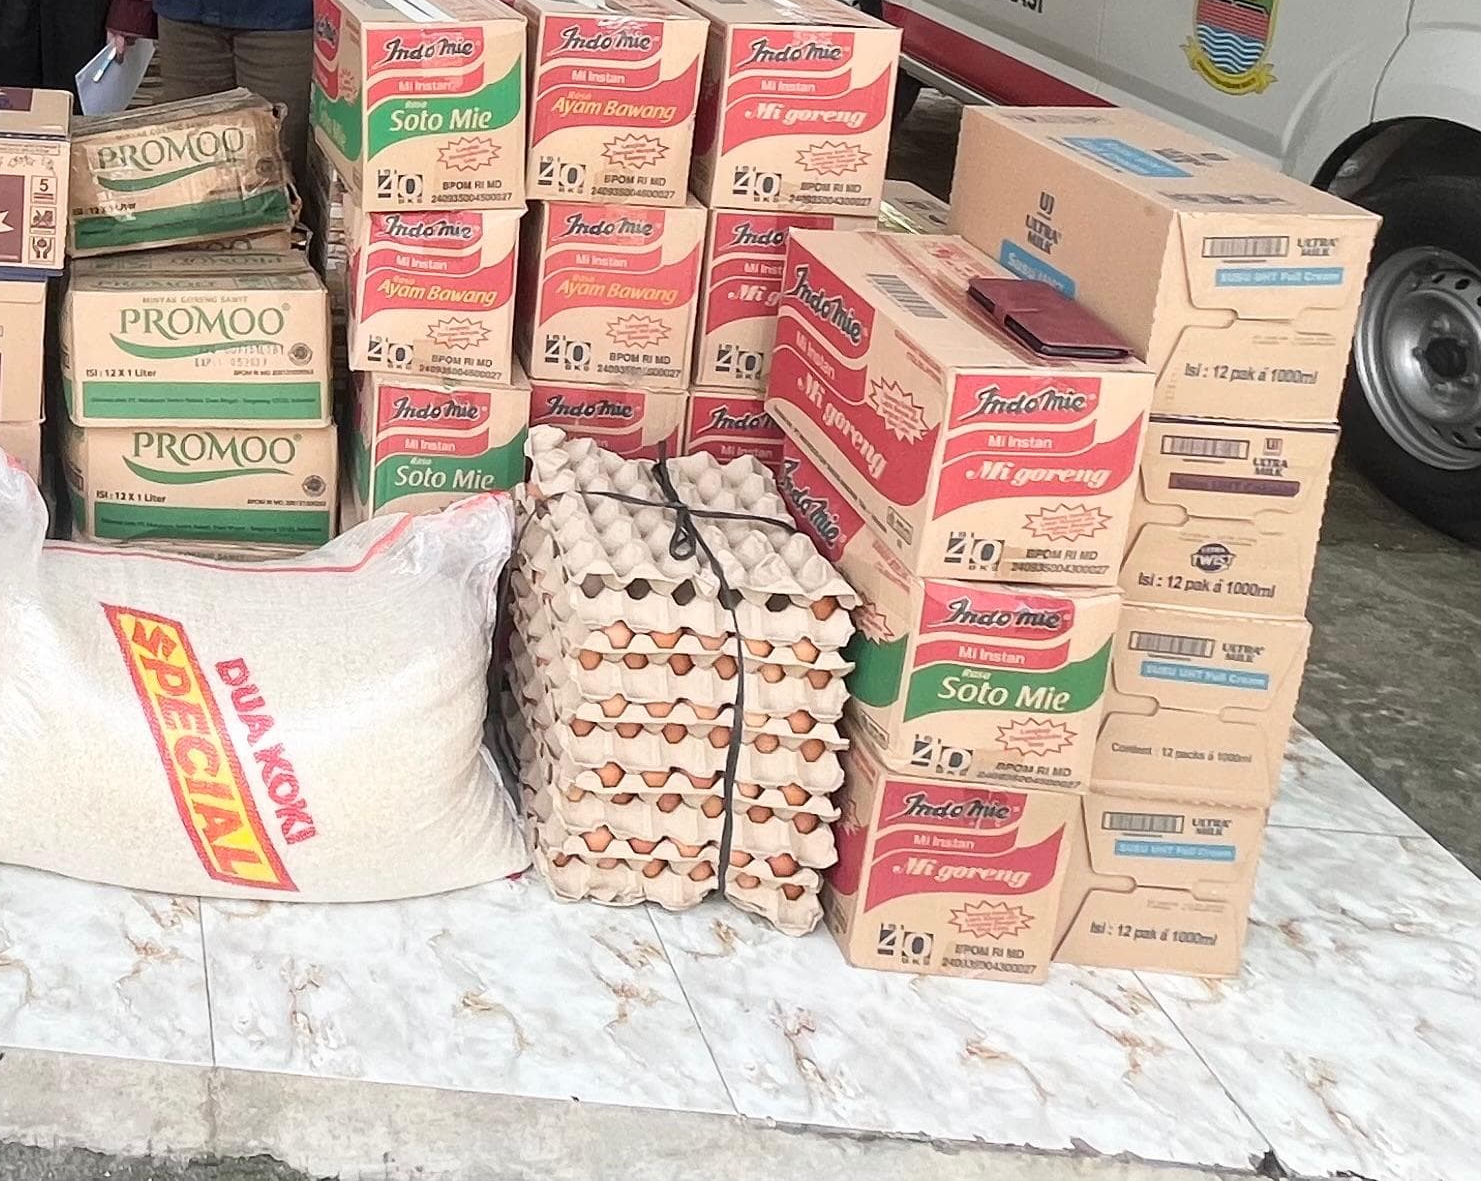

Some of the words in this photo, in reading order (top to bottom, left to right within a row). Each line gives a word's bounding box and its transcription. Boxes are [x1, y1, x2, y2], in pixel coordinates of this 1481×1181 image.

[389, 110, 443, 132] Soto
[449, 107, 493, 130] Mie
[551, 97, 601, 117] Ayam
[603, 101, 677, 123] Bawang
[744, 102, 784, 120] Mi
[783, 108, 867, 128] goreng
[97, 127, 244, 171] PROMOO
[39, 178, 49, 192] 5
[377, 278, 425, 299] Ayam
[427, 285, 497, 307] Bawang
[556, 279, 606, 298] Ayam
[608, 283, 678, 305] Bawang
[119, 306, 285, 340] PROMOO
[105, 369, 116, 377] 12
[135, 369, 157, 377] Liter
[1214, 365, 1229, 379] 12
[1230, 367, 1254, 382] pak
[1271, 369, 1319, 385] 1000ml
[133, 431, 296, 467] PROMOO
[822, 403, 887, 480] goreng
[394, 465, 448, 488] Soto
[452, 467, 495, 490] Mie
[965, 460, 1015, 481] Mi
[1010, 468, 1112, 489] goreng
[115, 492, 126, 501] 12
[144, 493, 166, 503] Liter
[1139, 572, 1155, 587] Isi
[1167, 575, 1181, 589] 12
[1184, 577, 1209, 592] pak
[1226, 581, 1276, 598] 1000ml
[938, 676, 1009, 707] Soto
[1015, 685, 1071, 711] Mie
[130, 620, 263, 875] SPECIAL
[215, 657, 275, 747] DUA
[253, 742, 317, 845] KOKI
[892, 857, 937, 876] Mi
[934, 864, 1031, 888] goreng
[1118, 924, 1131, 938] 12
[1134, 927, 1156, 941] pak
